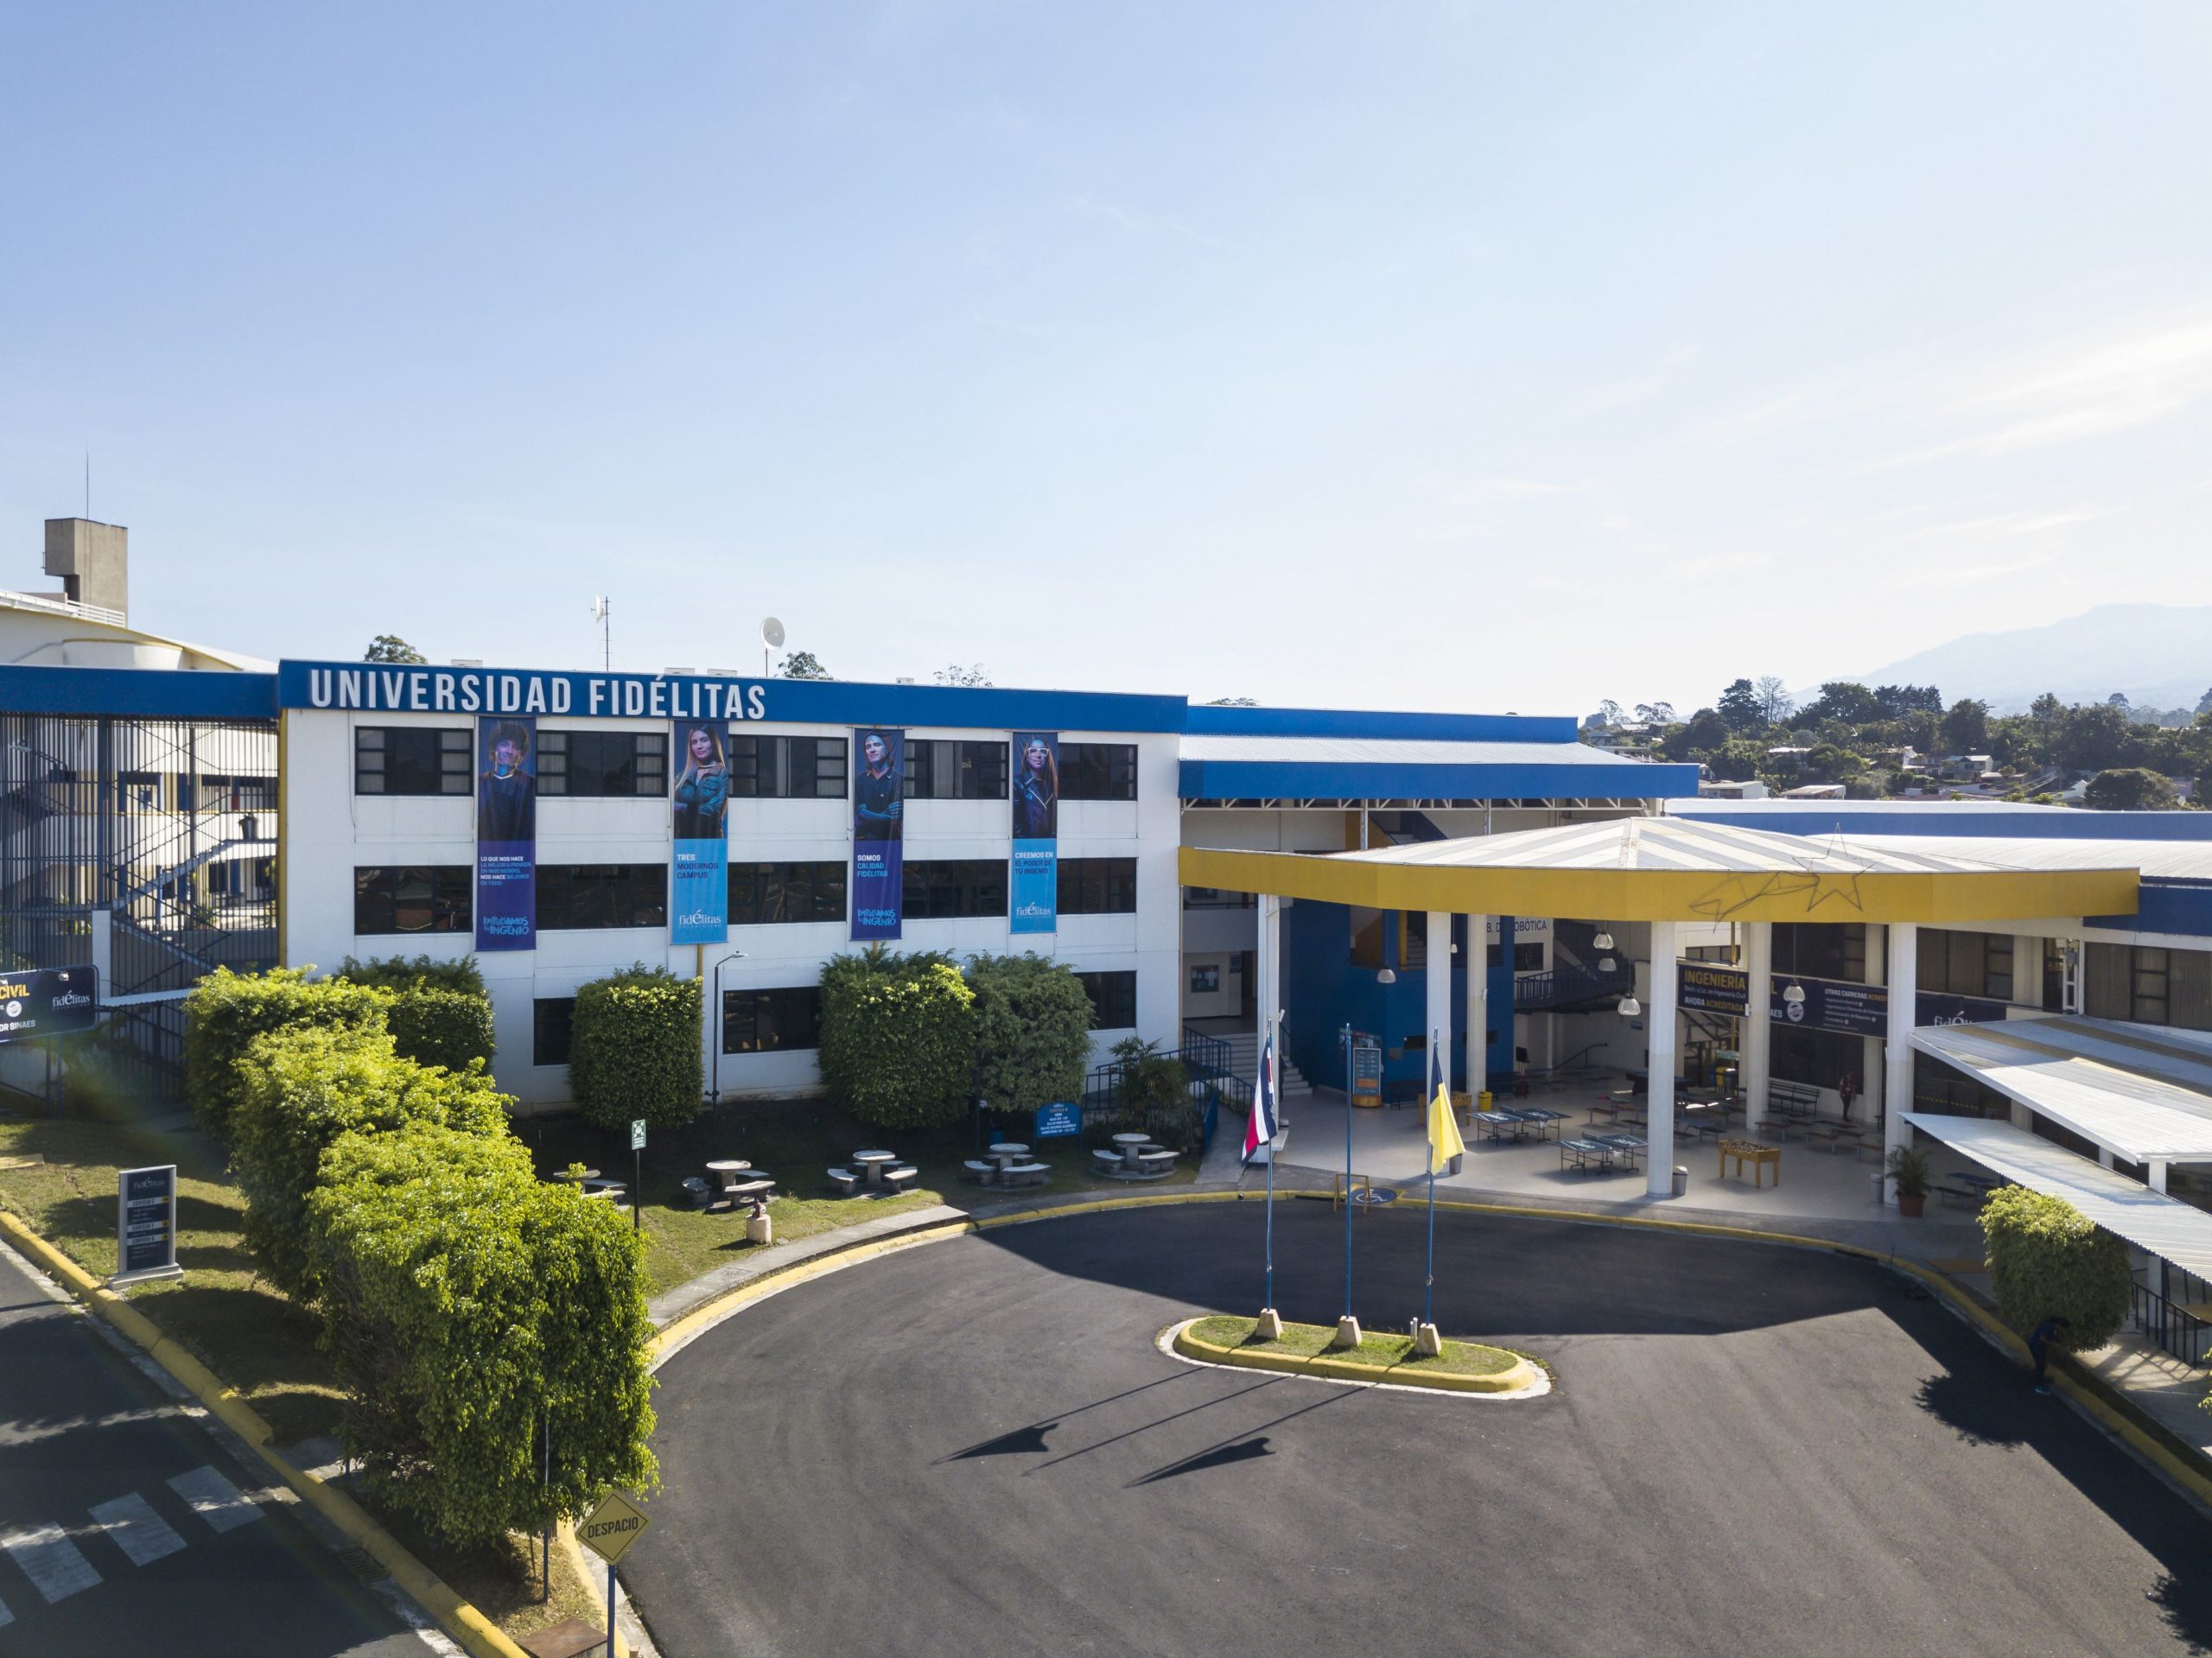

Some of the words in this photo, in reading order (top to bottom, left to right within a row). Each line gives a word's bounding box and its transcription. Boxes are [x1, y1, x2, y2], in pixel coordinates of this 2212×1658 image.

[311, 669, 571, 713] UNIVERSIDAD
[589, 674, 766, 720] FIDÉLITAS
[1016, 901, 1052, 916] fidélitas
[678, 909, 721, 924] fidélitas
[1514, 918, 1547, 932] OBÓTICA
[1684, 969, 1745, 991] INGENIERÍA
[53, 989, 91, 1007] fidélitas
[1684, 996, 1706, 1007] AHORA
[1825, 988, 1841, 996] OTRAS
[1841, 990, 1867, 1000] CARRERAS
[1770, 1008, 1783, 1018] AES
[10, 1020, 36, 1031] SINAES
[588, 1516, 639, 1539] DESPACIO
